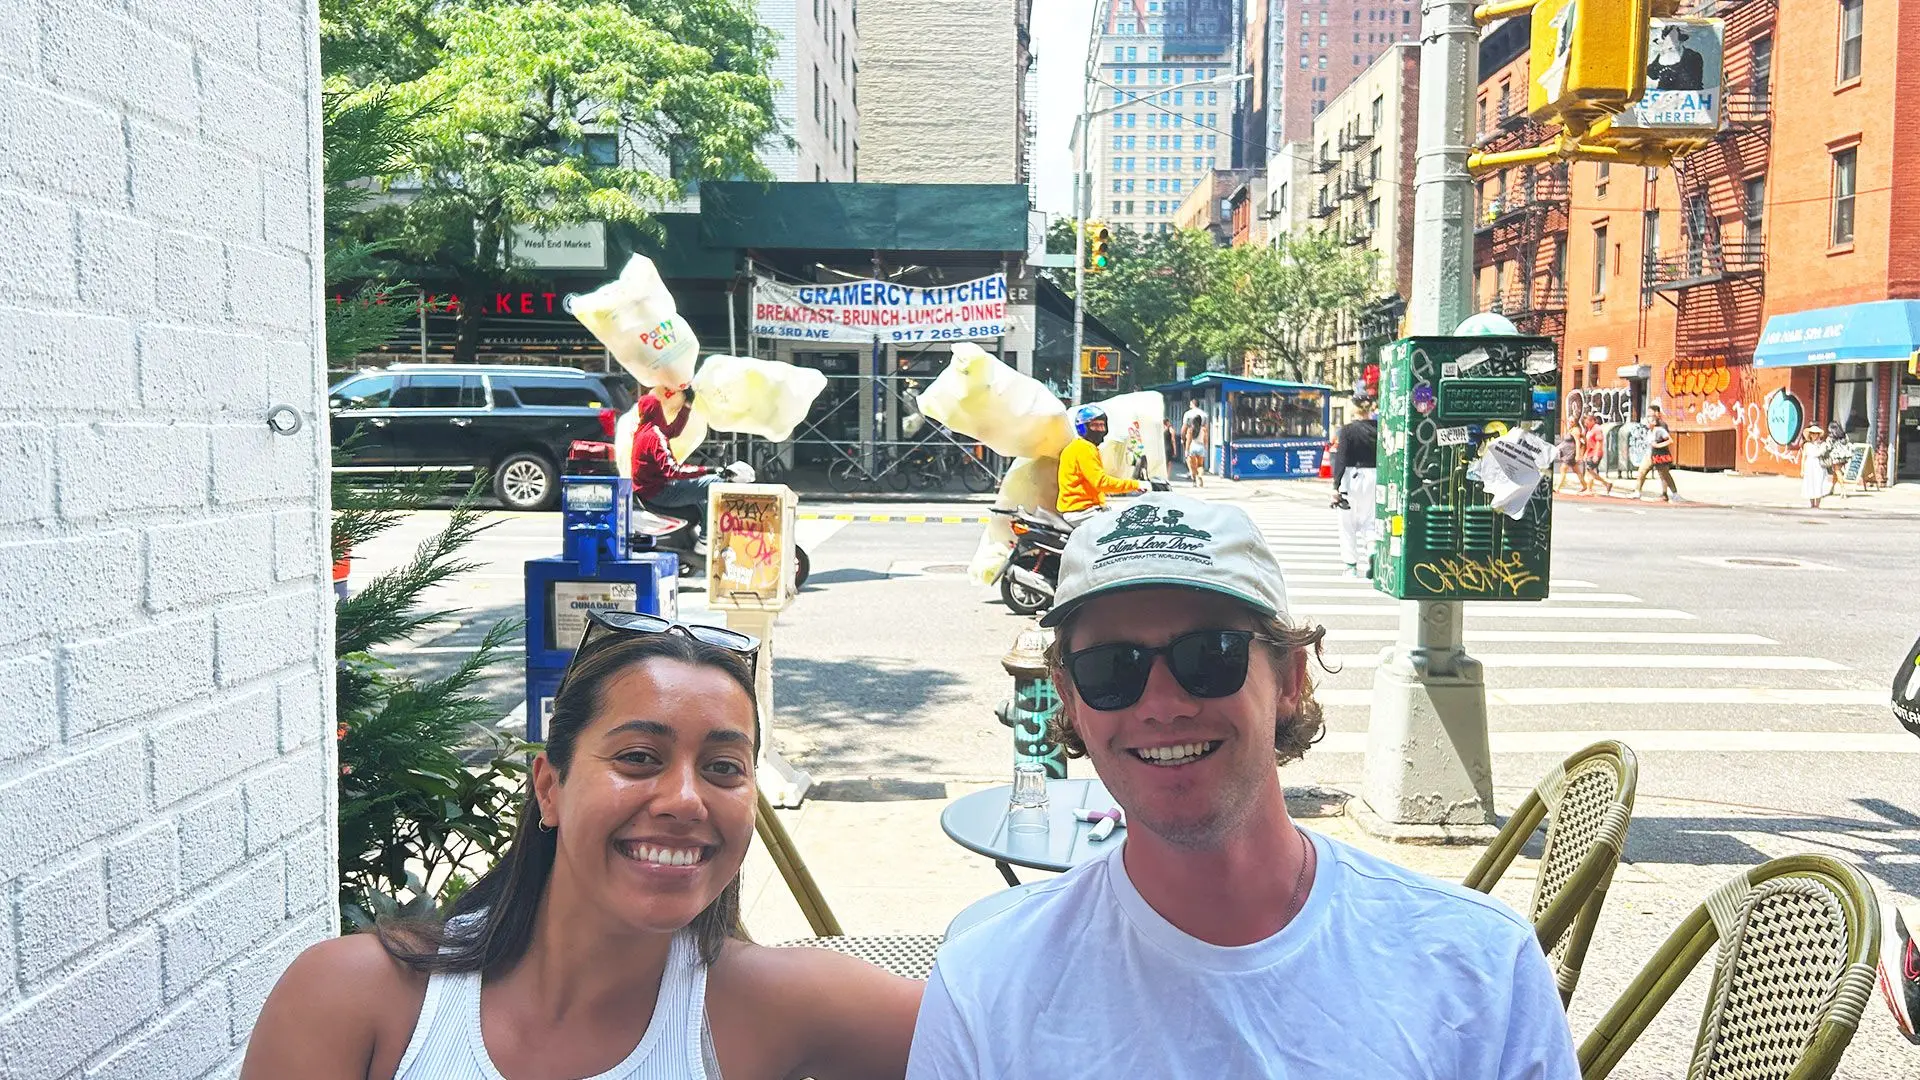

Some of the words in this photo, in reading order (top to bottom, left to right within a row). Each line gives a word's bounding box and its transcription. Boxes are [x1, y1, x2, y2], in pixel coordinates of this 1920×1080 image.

[524, 239, 544, 249] West
[547, 239, 562, 249] End
[564, 239, 592, 249] Market
[799, 282, 914, 306] GRAMERCY
[922, 276, 1007, 306] KITCHEN
[640, 319, 674, 345] Party
[778, 326, 802, 338] 3RD
[805, 328, 830, 339] AVE
[892, 330, 925, 341] 917
[931, 328, 963, 340] 265
[1446, 388, 1480, 398] TRAFFIC
[1483, 388, 1521, 398] CONTROL
[1450, 400, 1469, 410] NEW
[1136, 535, 1168, 549] Leon
[1166, 536, 1199, 551] Dore
[1184, 555, 1213, 566] BOROUGH
[570, 601, 595, 610] CHINA
[596, 601, 621, 610] DAILY
